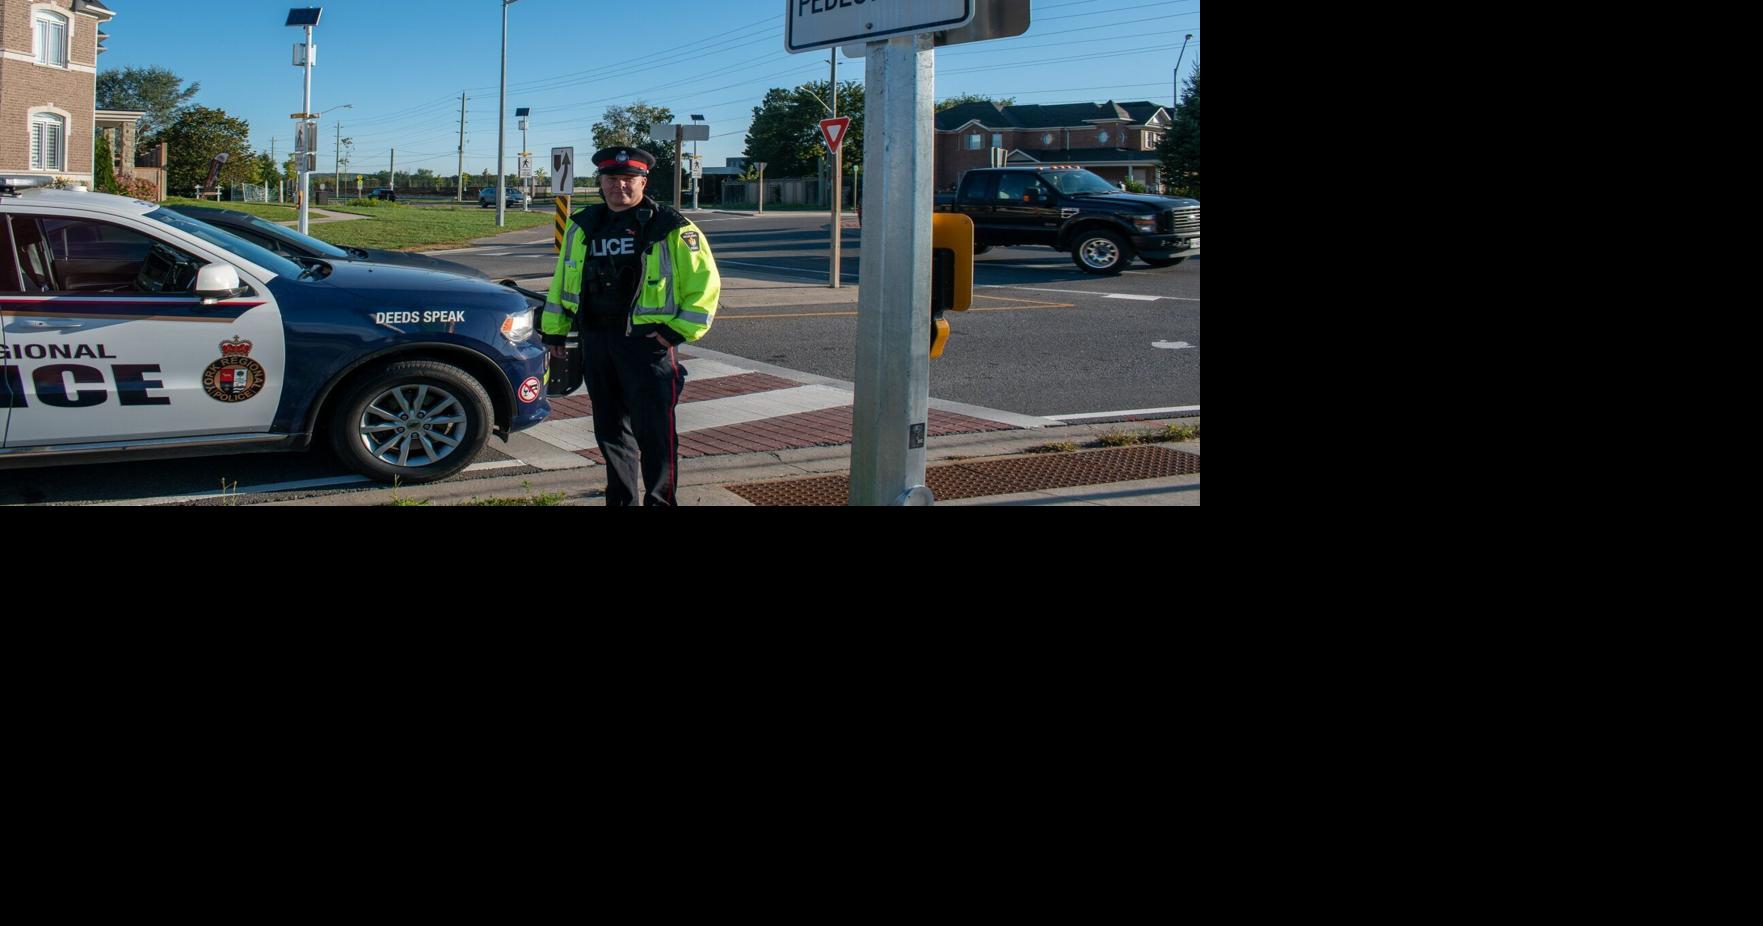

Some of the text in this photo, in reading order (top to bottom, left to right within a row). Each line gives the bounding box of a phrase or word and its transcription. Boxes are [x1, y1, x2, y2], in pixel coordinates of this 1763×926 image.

[590, 237, 635, 256] LICE
[376, 310, 465, 324] DEEDS SPEAK
[203, 357, 263, 392] YORK REGIONAL
[213, 390, 254, 402] POLICE
